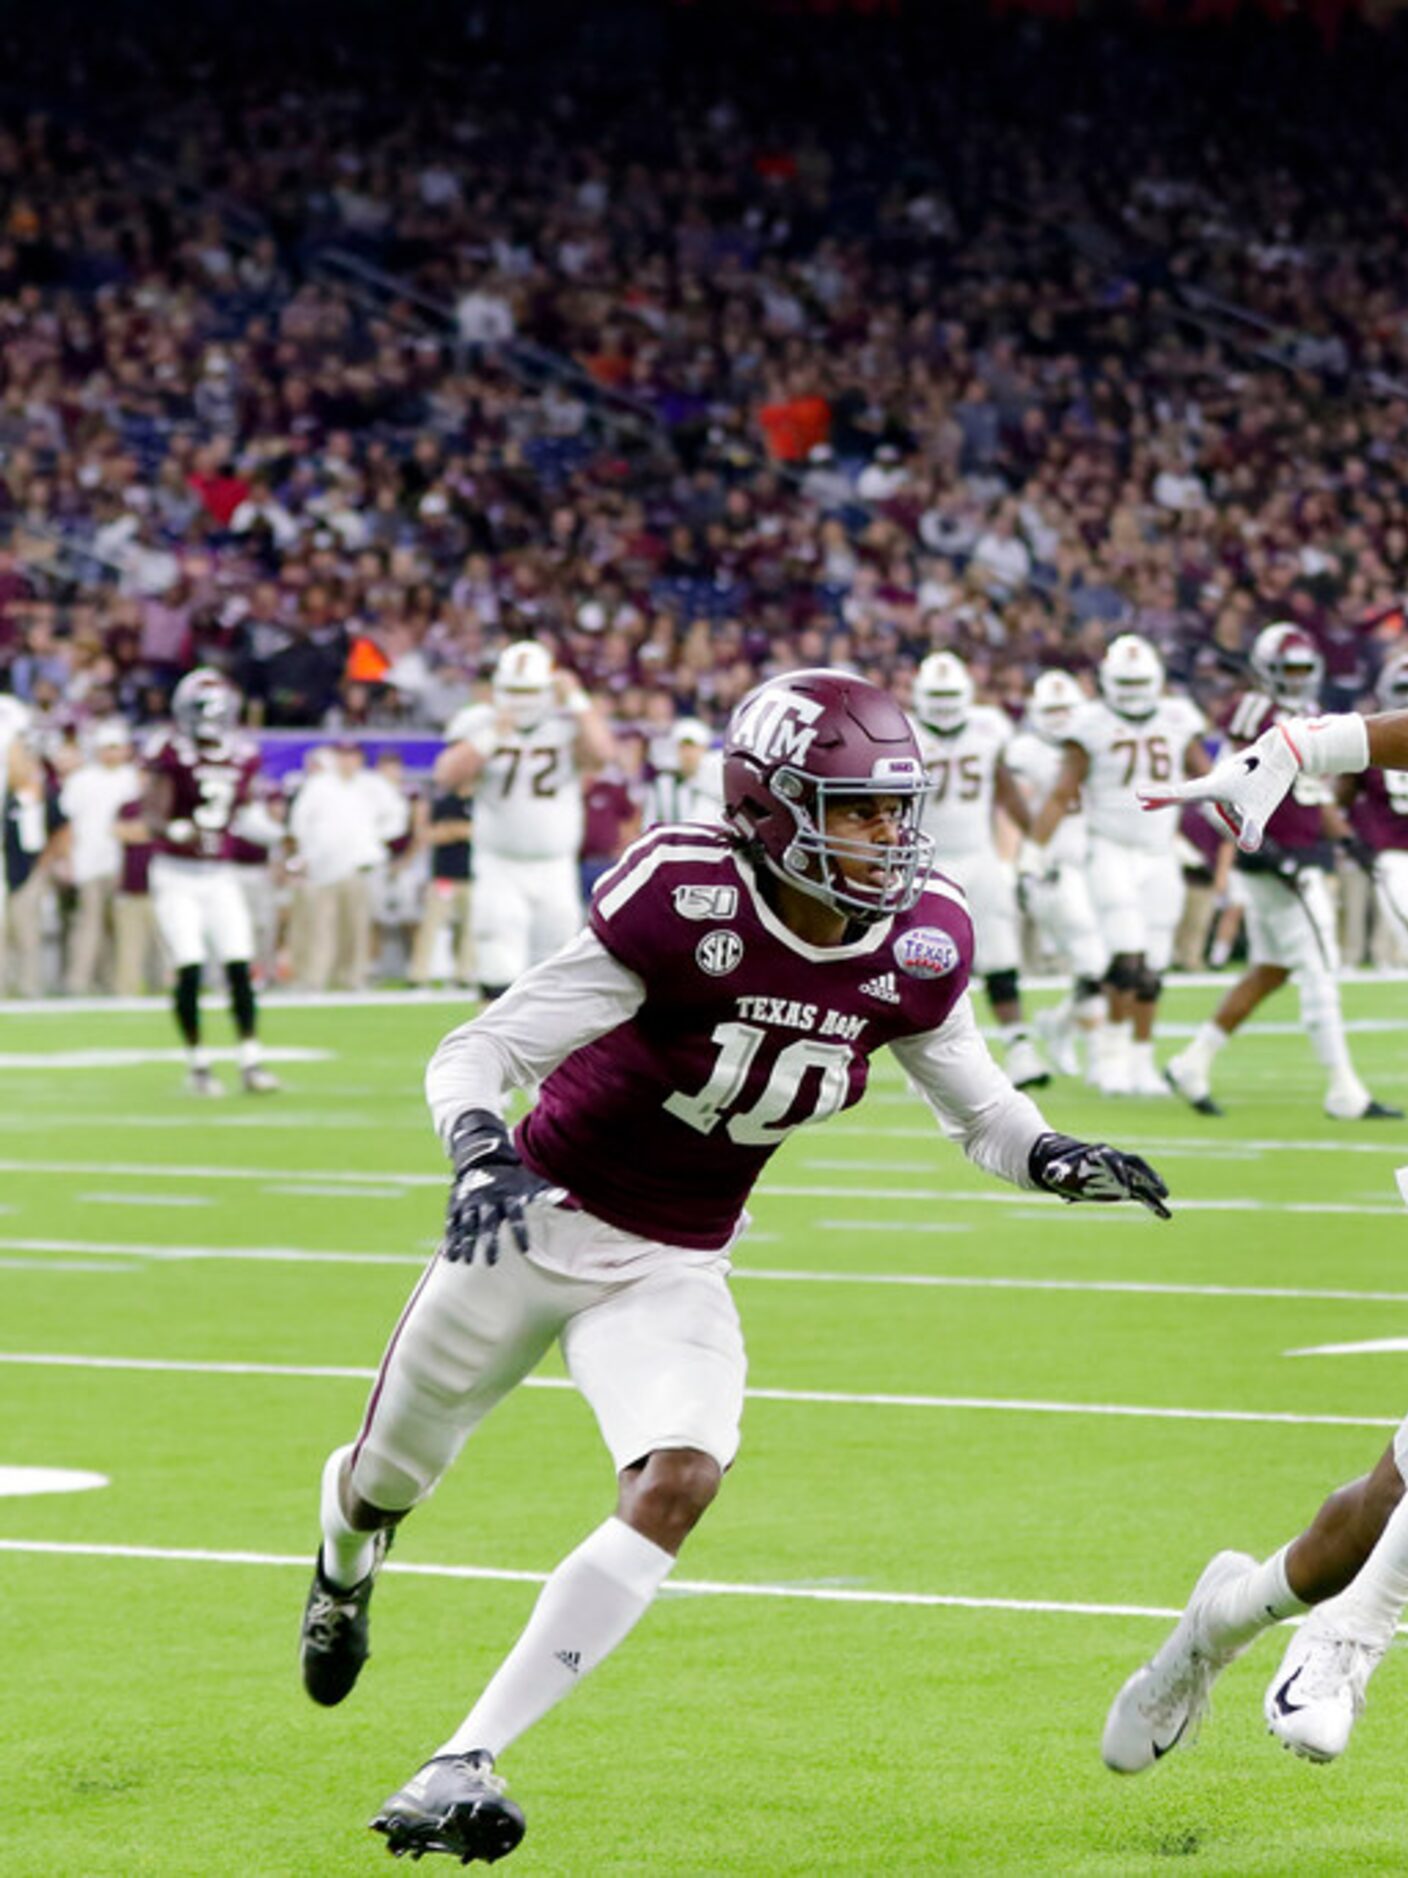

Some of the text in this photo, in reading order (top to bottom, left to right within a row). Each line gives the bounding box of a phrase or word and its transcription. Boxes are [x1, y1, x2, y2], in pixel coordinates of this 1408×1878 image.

[492, 747, 560, 798] 72
[926, 755, 984, 804] 75
[1110, 736, 1171, 788] 76
[192, 779, 236, 829] 3
[906, 939, 953, 969] TEXAS
[735, 995, 869, 1041] TEXAS A&M
[661, 1022, 855, 1146] 10
